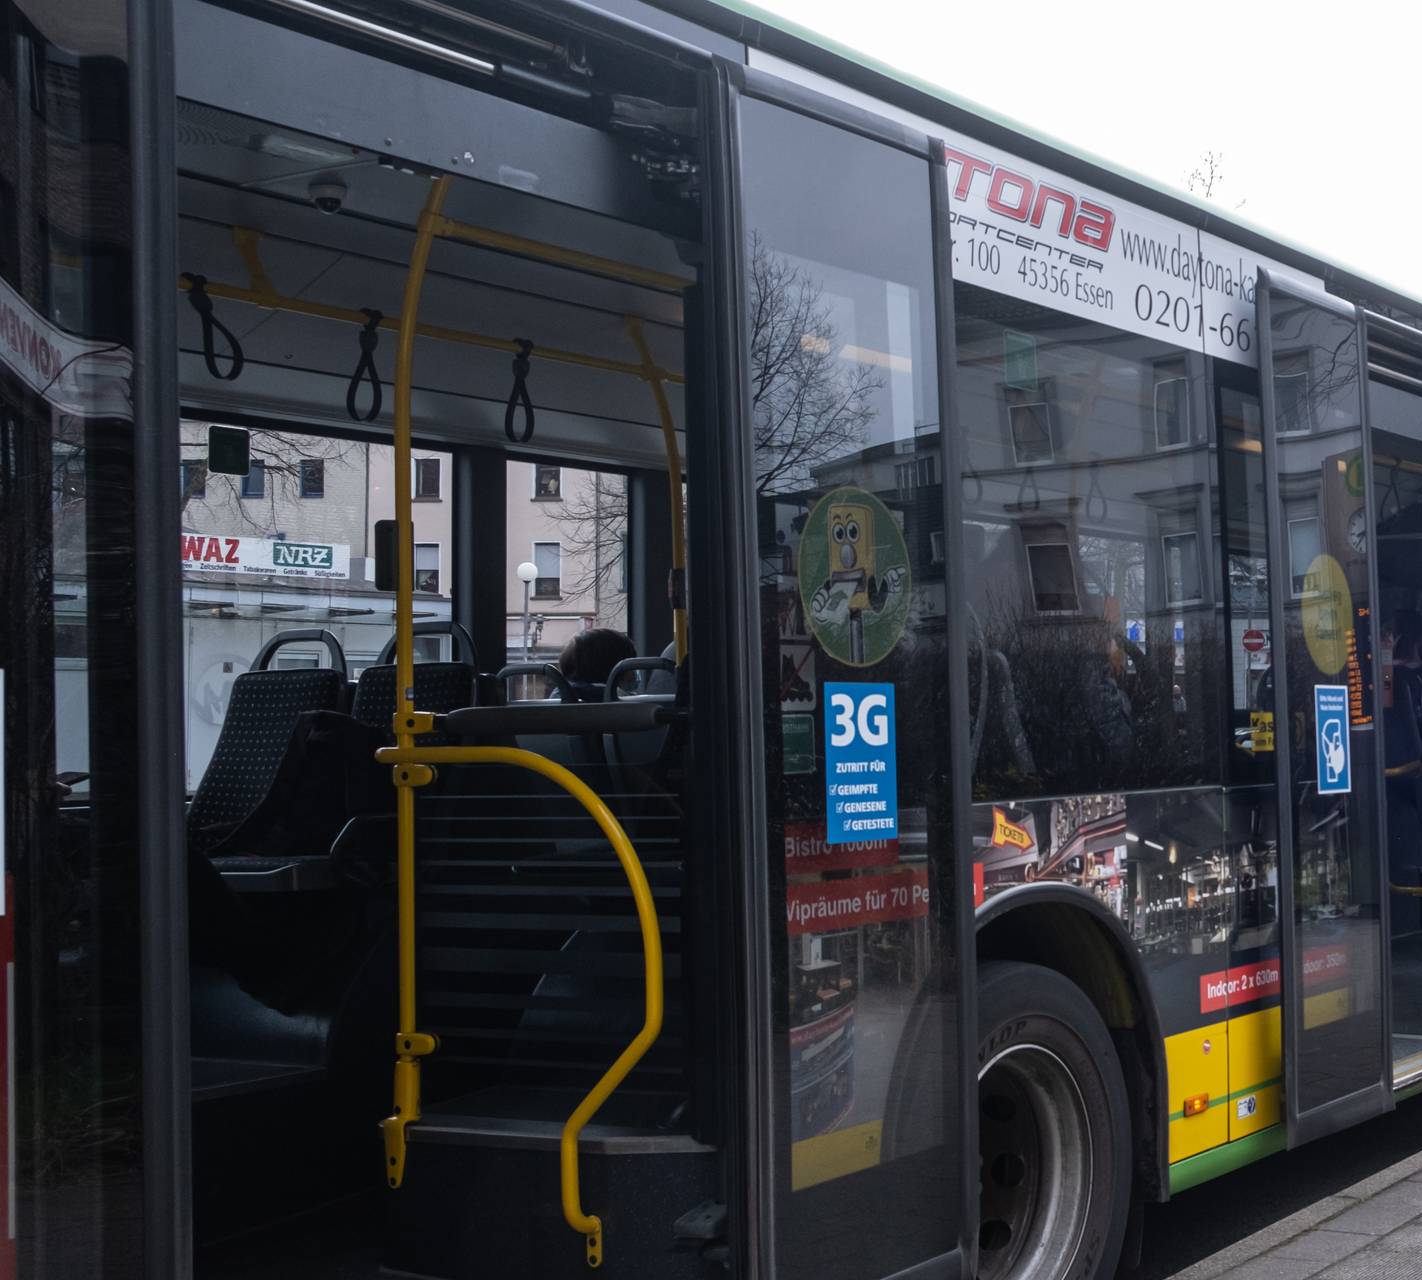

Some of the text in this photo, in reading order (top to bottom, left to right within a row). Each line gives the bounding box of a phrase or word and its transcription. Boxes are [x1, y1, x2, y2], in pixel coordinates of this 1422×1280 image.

[968, 238, 1001, 275] 100
[1017, 255, 1070, 297] 45356
[1075, 272, 1113, 310] Essen
[1135, 284, 1250, 351] 0201-66
[182, 536, 240, 564] WAZ
[276, 546, 330, 566] NRZ
[831, 694, 889, 747] 3G
[836, 760, 886, 774] ZUTRITT FÜR
[838, 784, 878, 796] GEIMPFTE
[844, 801, 887, 814] GENESENE
[852, 818, 895, 831] GETESTETE
[1000, 824, 1024, 844] TICKETS
[784, 836, 833, 858] Bistro
[786, 884, 929, 926] Vipräume für 70 Pe
[1242, 974, 1248, 990] 2
[1248, 975, 1255, 988] x
[1256, 969, 1279, 986] 630m
